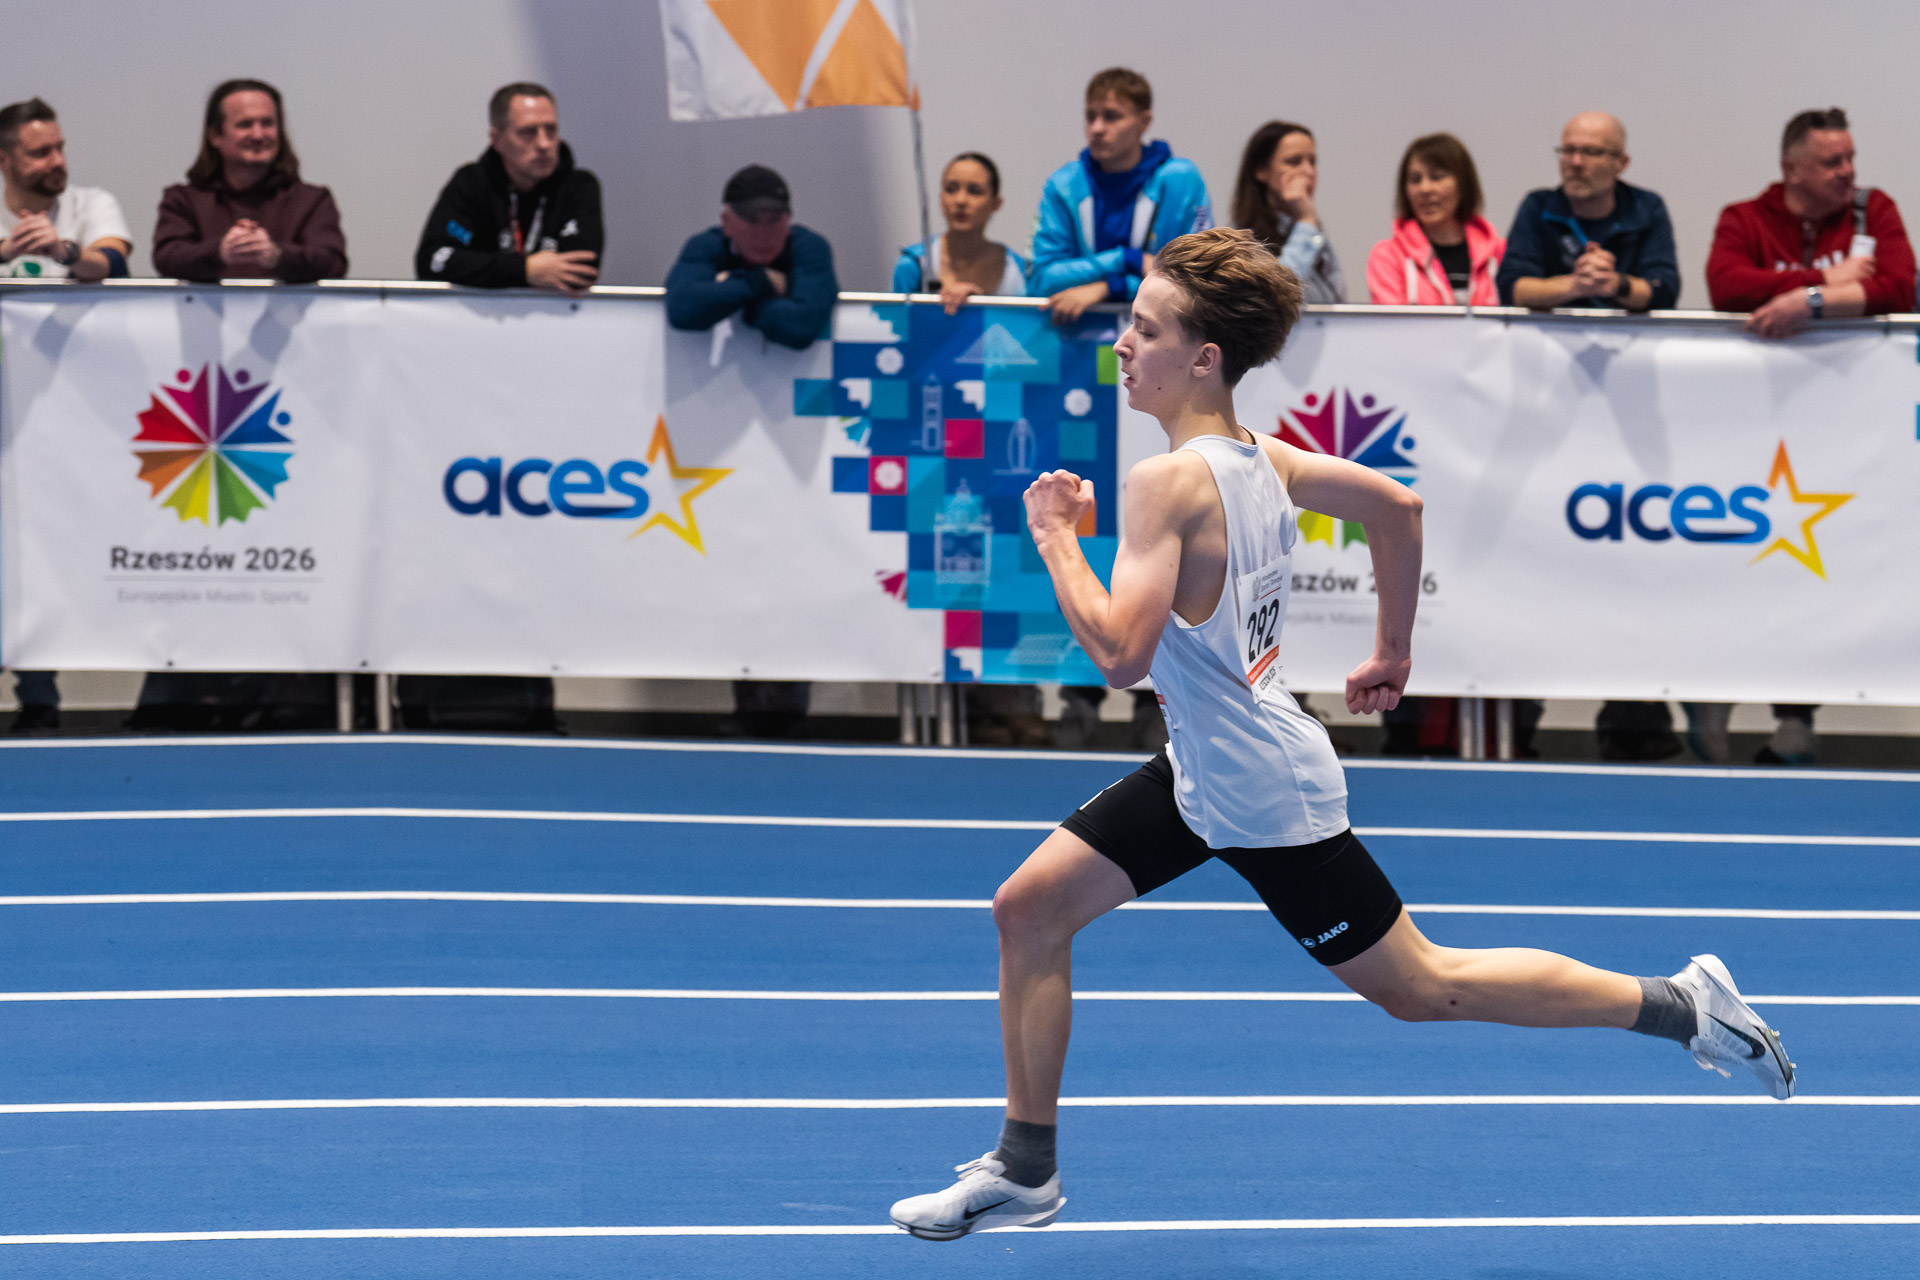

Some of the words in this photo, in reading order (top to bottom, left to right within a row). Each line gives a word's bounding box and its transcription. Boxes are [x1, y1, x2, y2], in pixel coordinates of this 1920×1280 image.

[443, 456, 650, 519] aces
[1566, 483, 1771, 544] aces
[111, 545, 235, 571] Rzeszów
[244, 547, 316, 571] 2026
[1290, 567, 1358, 592] szów
[1247, 598, 1279, 663] 292
[1317, 921, 1349, 943] JAKO
